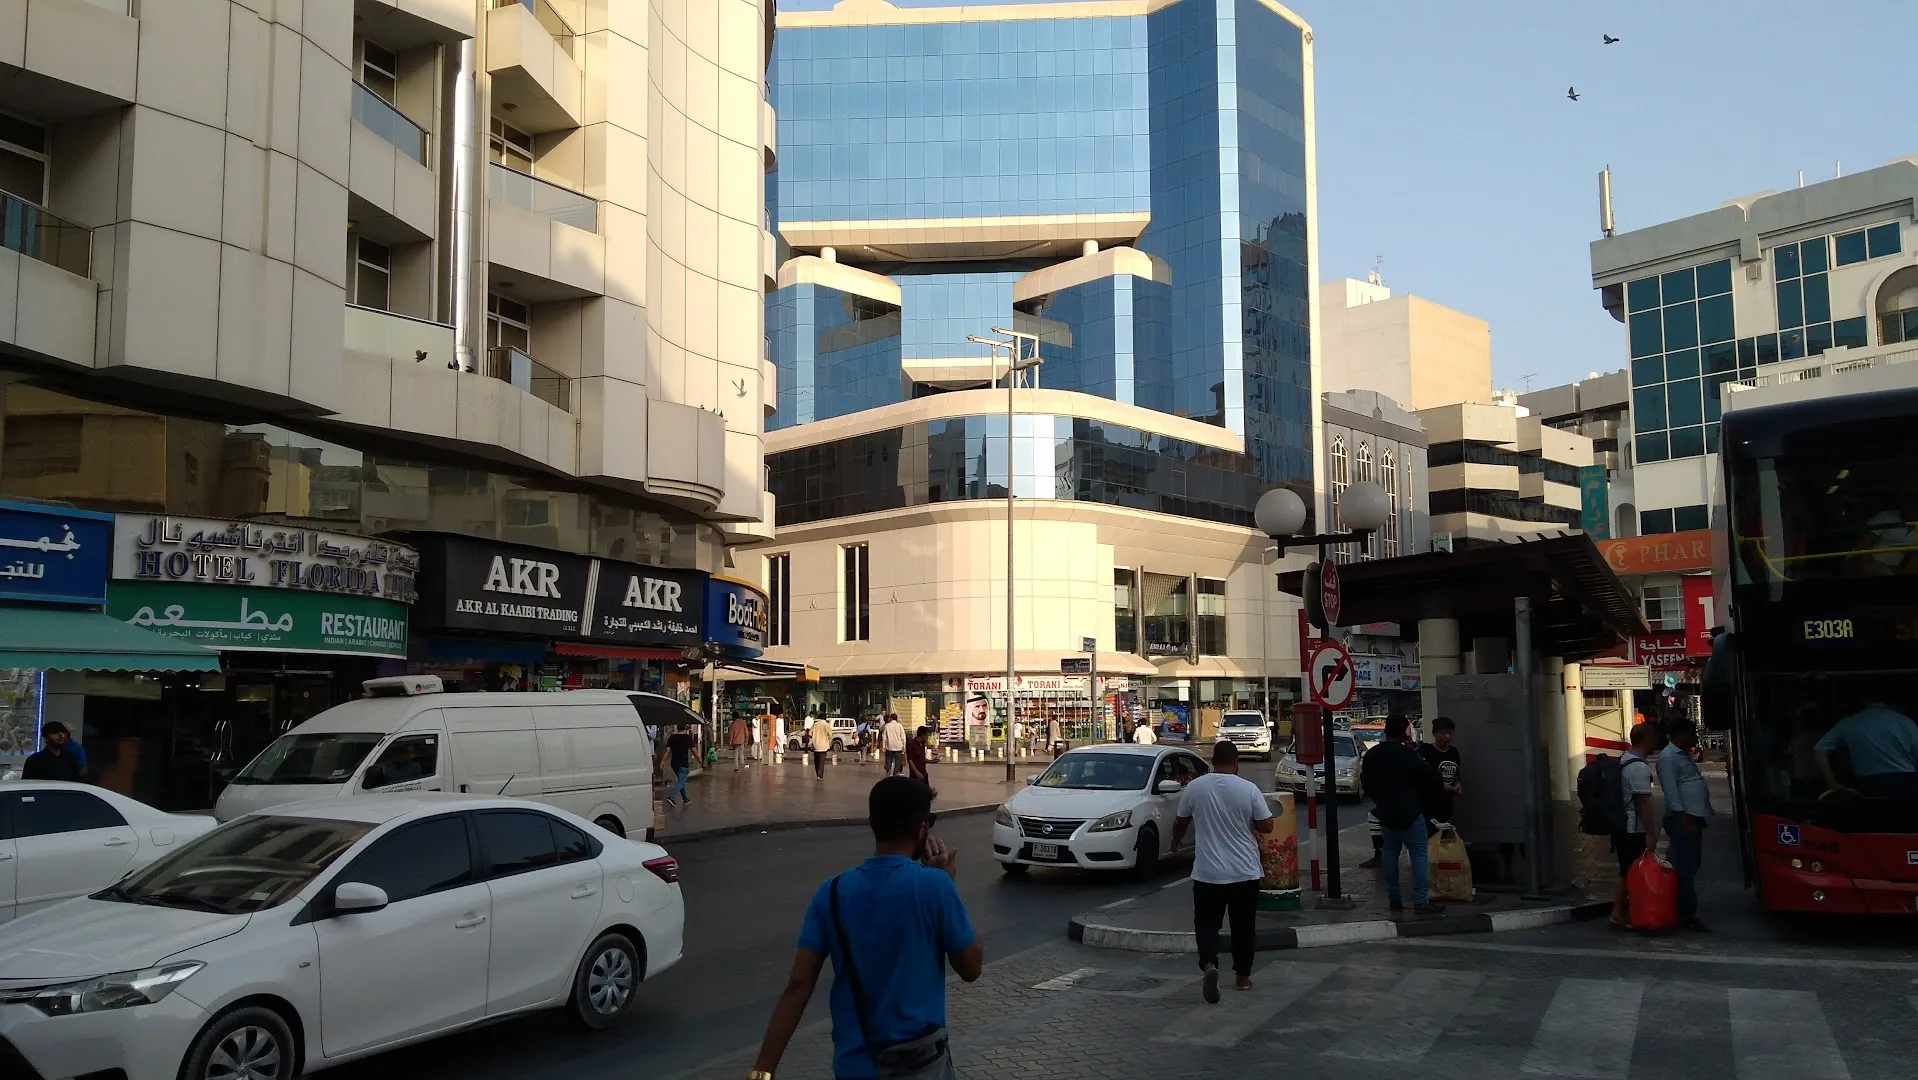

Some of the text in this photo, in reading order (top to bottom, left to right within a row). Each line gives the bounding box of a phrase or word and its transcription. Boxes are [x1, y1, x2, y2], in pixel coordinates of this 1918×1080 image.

[1639, 540, 1706, 563] PHAR
[0, 560, 45, 580] للتج
[136, 551, 256, 582] HOTEL
[271, 559, 381, 594] FLORIDA
[483, 555, 562, 599] AKR
[622, 575, 683, 613] AKR
[1324, 591, 1338, 610] STOP
[127, 597, 293, 633] مطعم
[456, 598, 578, 623] AKR AL KAAIBI TRADING
[233, 631, 252, 641] كباب
[321, 612, 405, 641] RESTAURANT
[1804, 618, 1854, 640] E303A
[261, 633, 281, 643] مندي
[324, 636, 345, 645] INDIAN
[348, 638, 367, 646] ARABIC
[1640, 637, 1687, 653] لخاجة
[967, 682, 1001, 690] TORANI
[1027, 680, 1061, 689] TORANI
